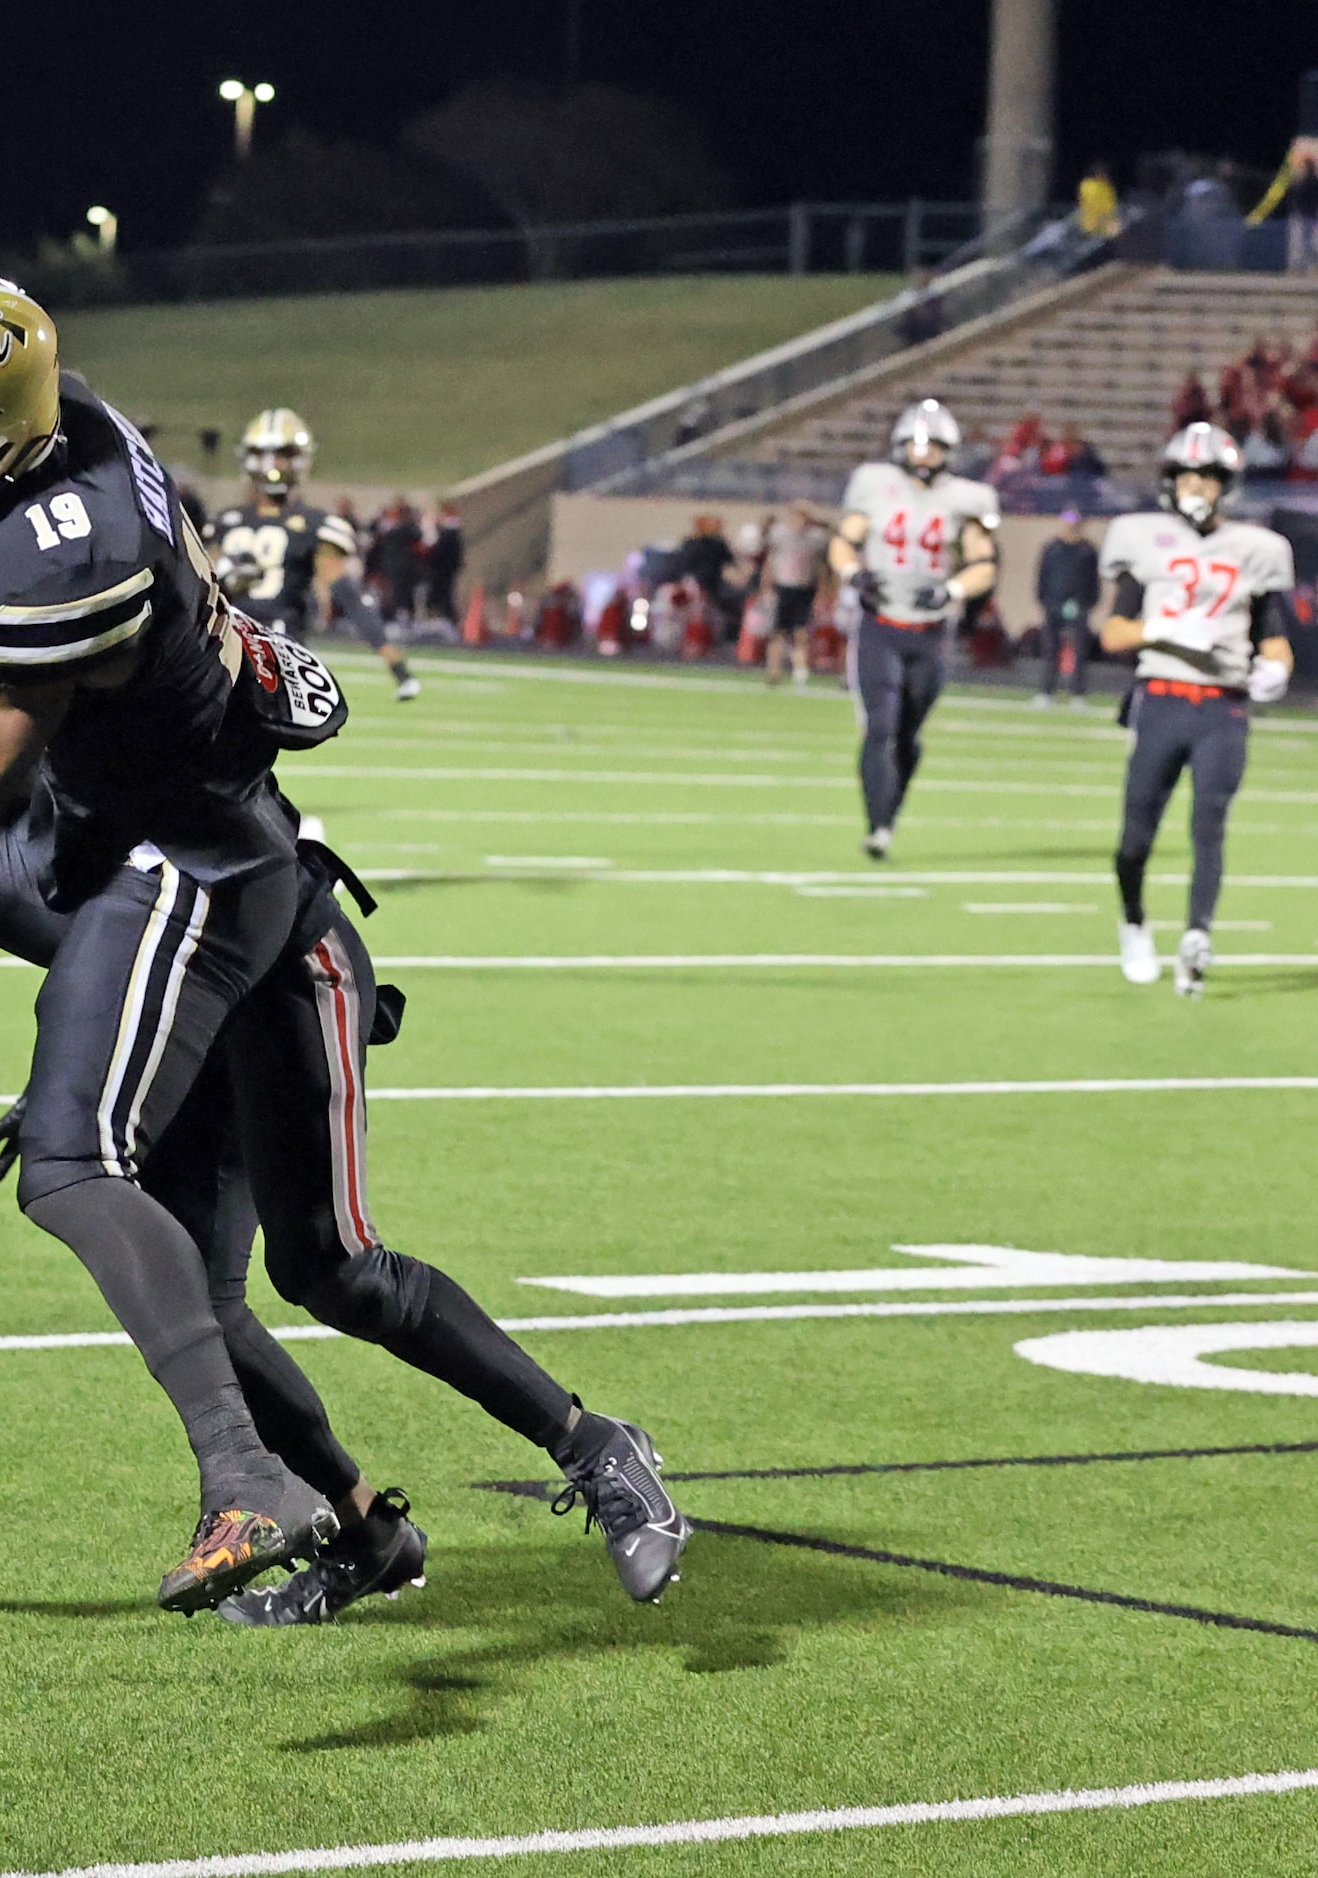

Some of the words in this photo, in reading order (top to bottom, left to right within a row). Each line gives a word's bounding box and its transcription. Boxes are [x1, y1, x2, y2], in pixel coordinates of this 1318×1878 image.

[24, 491, 93, 552] 19
[881, 511, 945, 571] 44
[1160, 556, 1240, 620] 37
